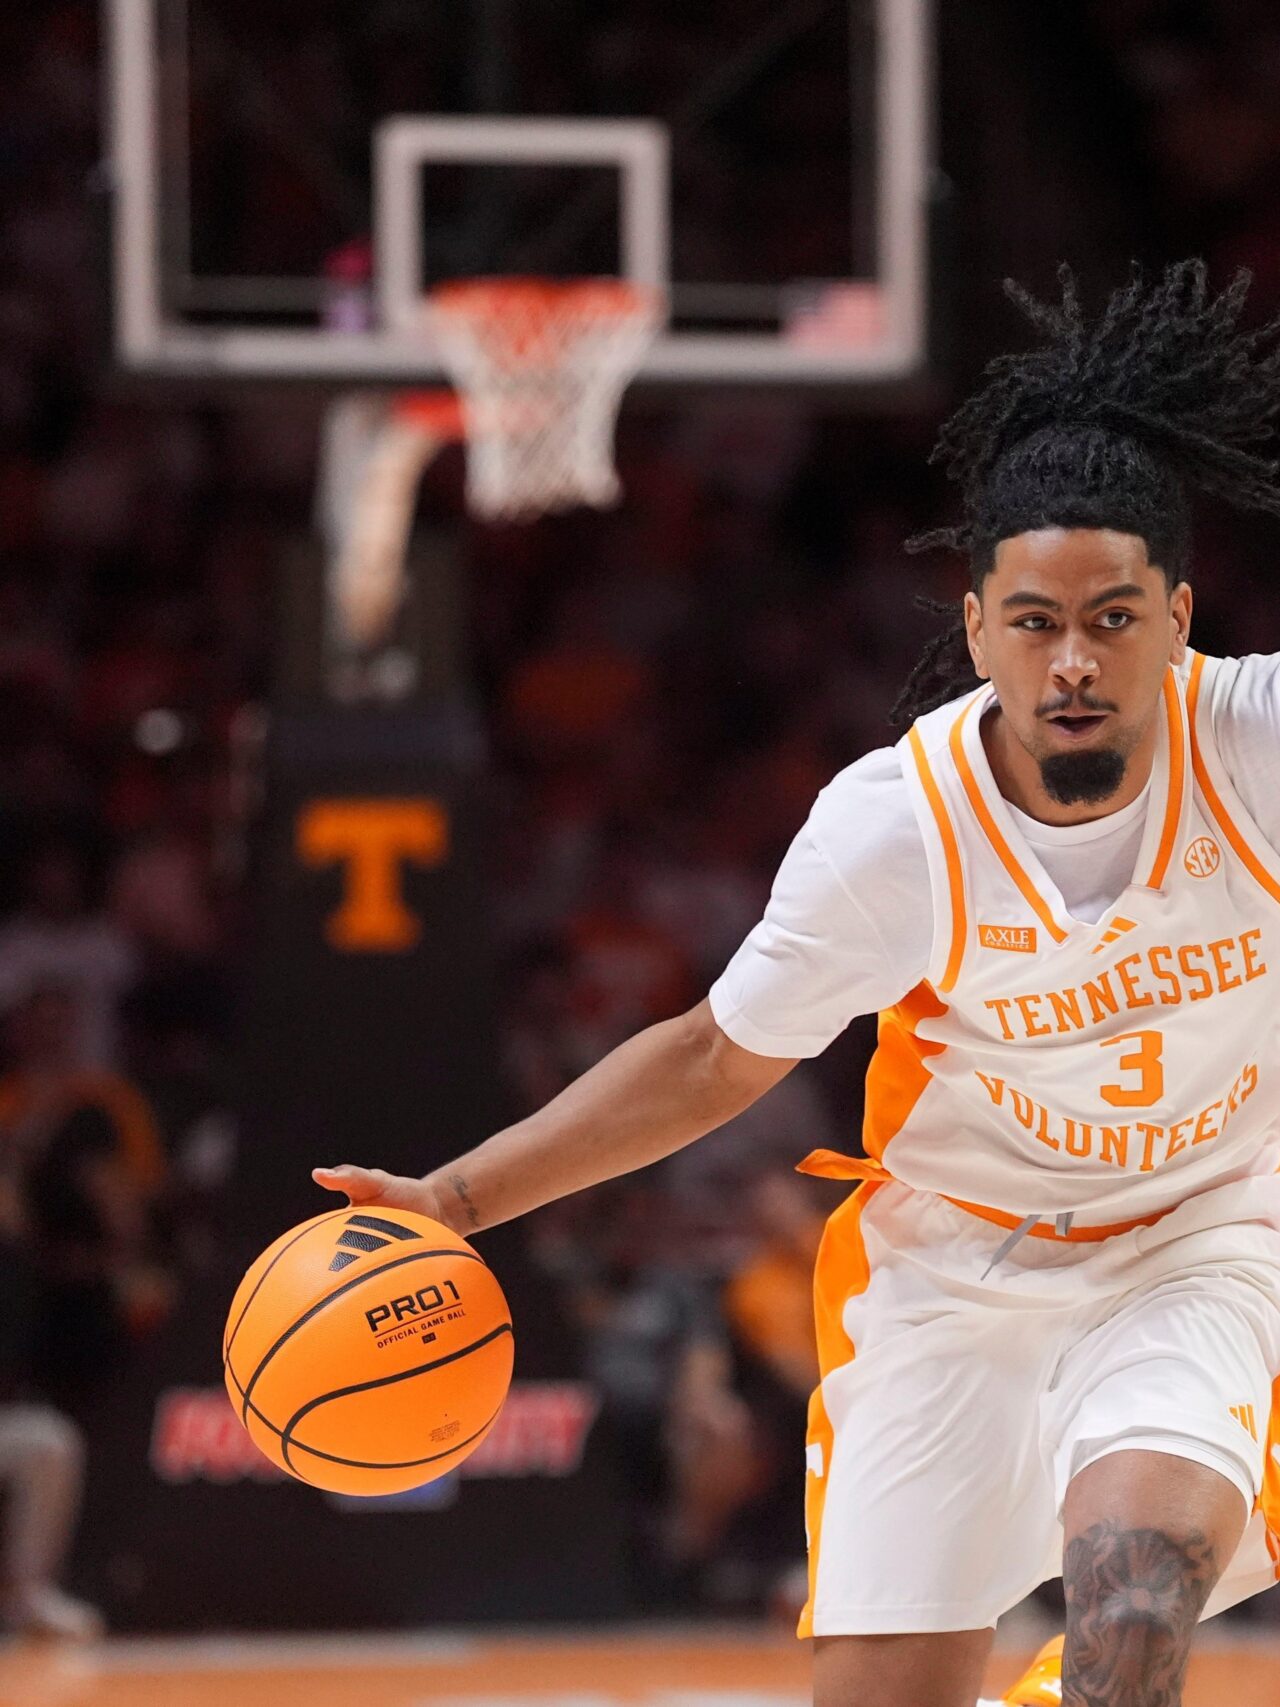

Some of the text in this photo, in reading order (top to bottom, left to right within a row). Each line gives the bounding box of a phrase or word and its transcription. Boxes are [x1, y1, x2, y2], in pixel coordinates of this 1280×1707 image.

[299, 799, 447, 953] T
[1184, 838, 1220, 877] SEC
[985, 928, 1030, 945] AXLE
[984, 928, 1268, 1040] TENNESSEE
[1100, 1030, 1164, 1107] 3
[377, 1327, 418, 1349] OFFICIAL
[420, 1316, 446, 1331] GAME
[447, 1308, 467, 1321] BALL
